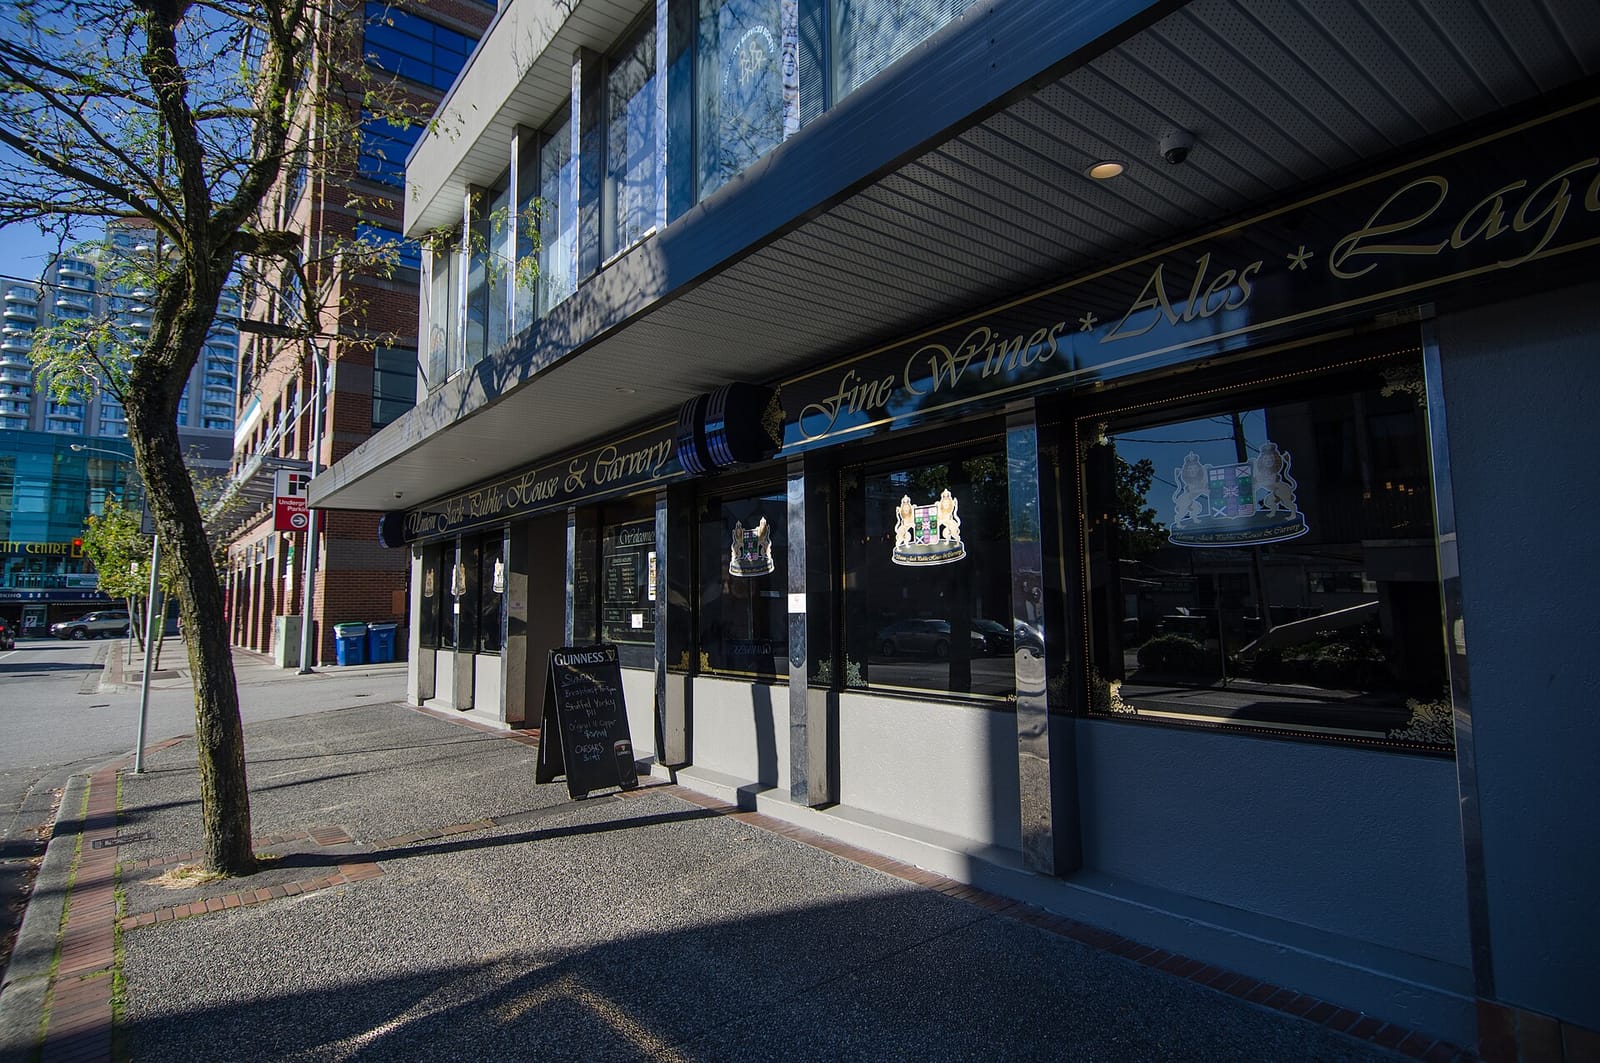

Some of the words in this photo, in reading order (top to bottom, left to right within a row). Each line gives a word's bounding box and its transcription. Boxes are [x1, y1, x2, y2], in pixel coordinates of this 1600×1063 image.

[799, 368, 896, 440] Fine
[903, 322, 1066, 397] Wines
[1099, 252, 1263, 345] Ales
[408, 511, 437, 534] Union
[437, 499, 465, 533] Jack
[470, 492, 503, 518] Public
[507, 471, 559, 508] House
[564, 459, 589, 493] &
[593, 439, 672, 485] Carvery
[0, 541, 20, 553] ITY
[25, 542, 67, 554] CENTRE
[554, 653, 605, 666] GUINNESS
